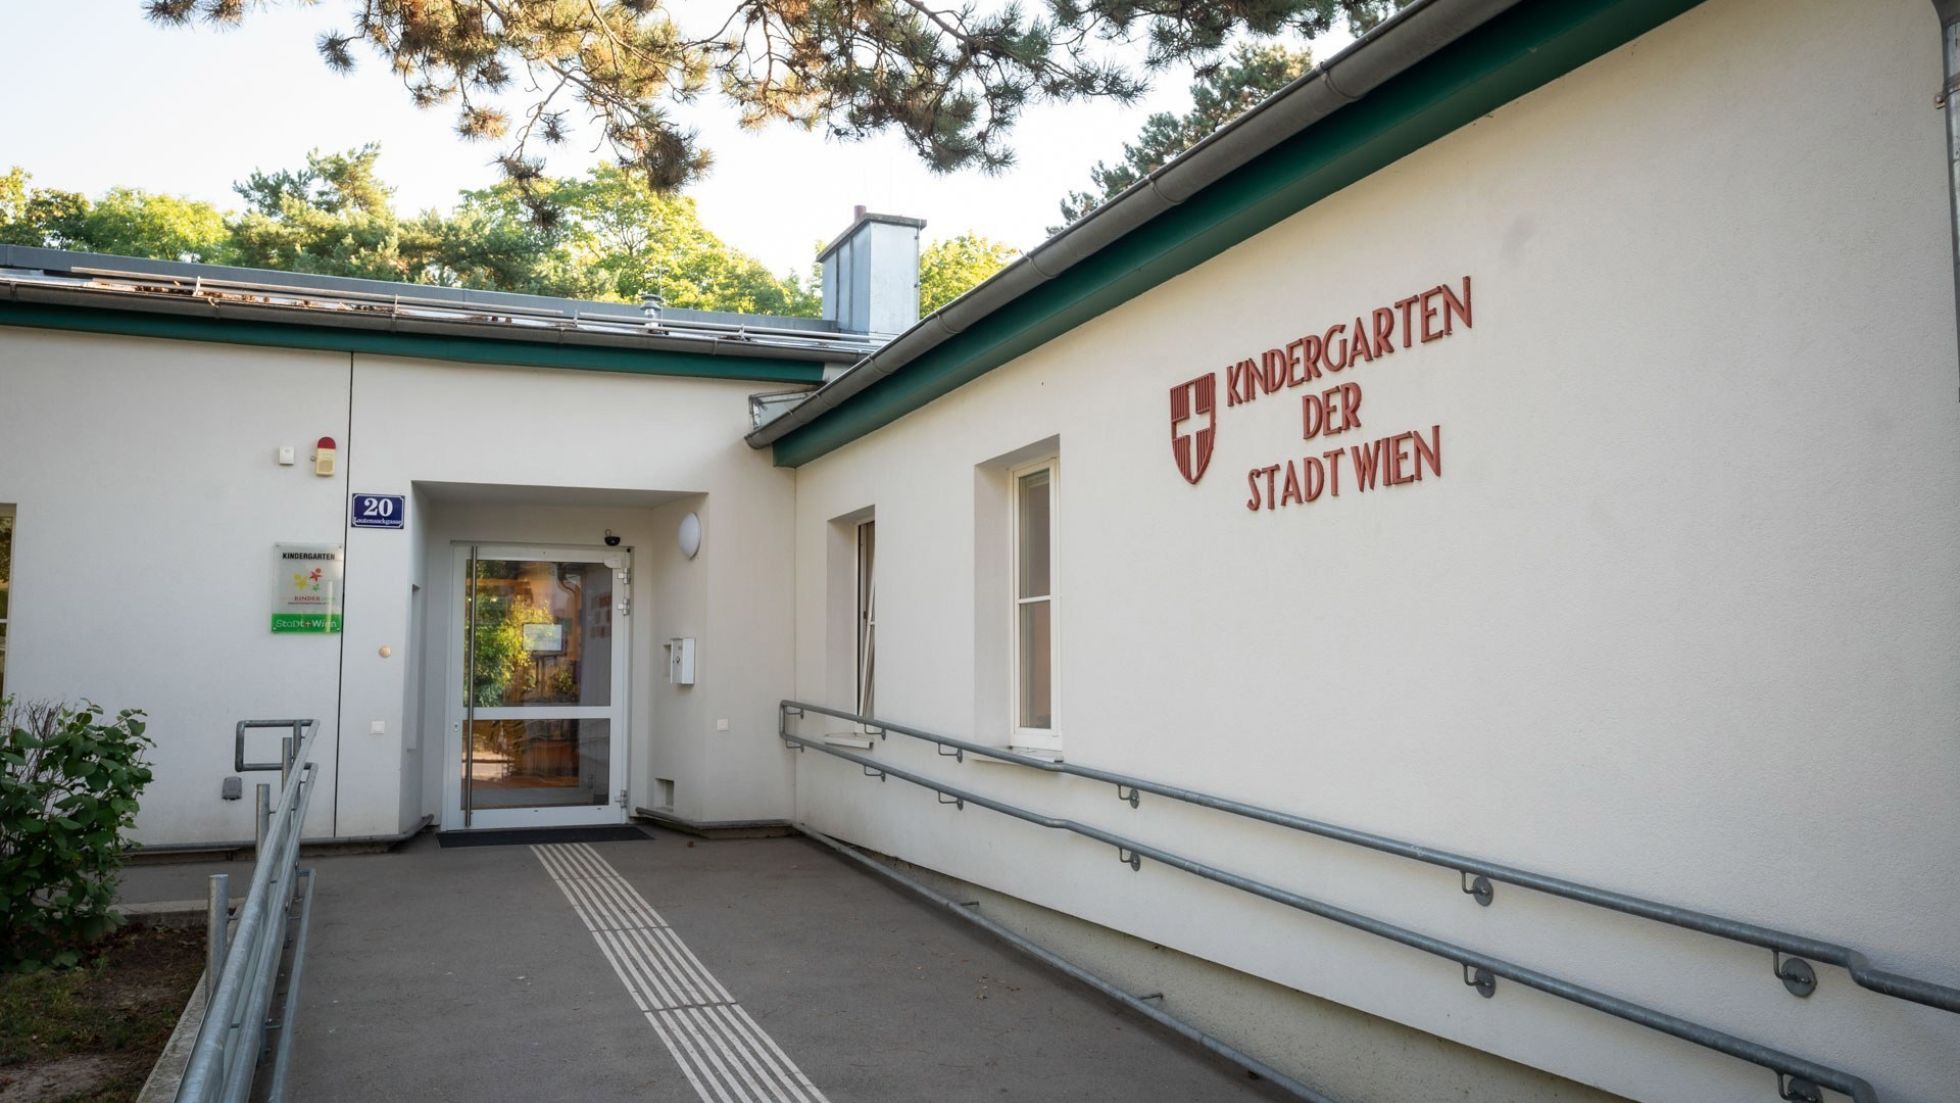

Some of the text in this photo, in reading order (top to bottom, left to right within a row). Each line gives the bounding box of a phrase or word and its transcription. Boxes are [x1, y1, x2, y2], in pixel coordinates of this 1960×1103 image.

[1226, 276, 1472, 407] KINDERGARTEN
[1302, 382, 1362, 439] DER
[1247, 425, 1441, 511] STADT WIEN
[363, 497, 393, 517] 20
[282, 552, 335, 560] KINDERGARTEN
